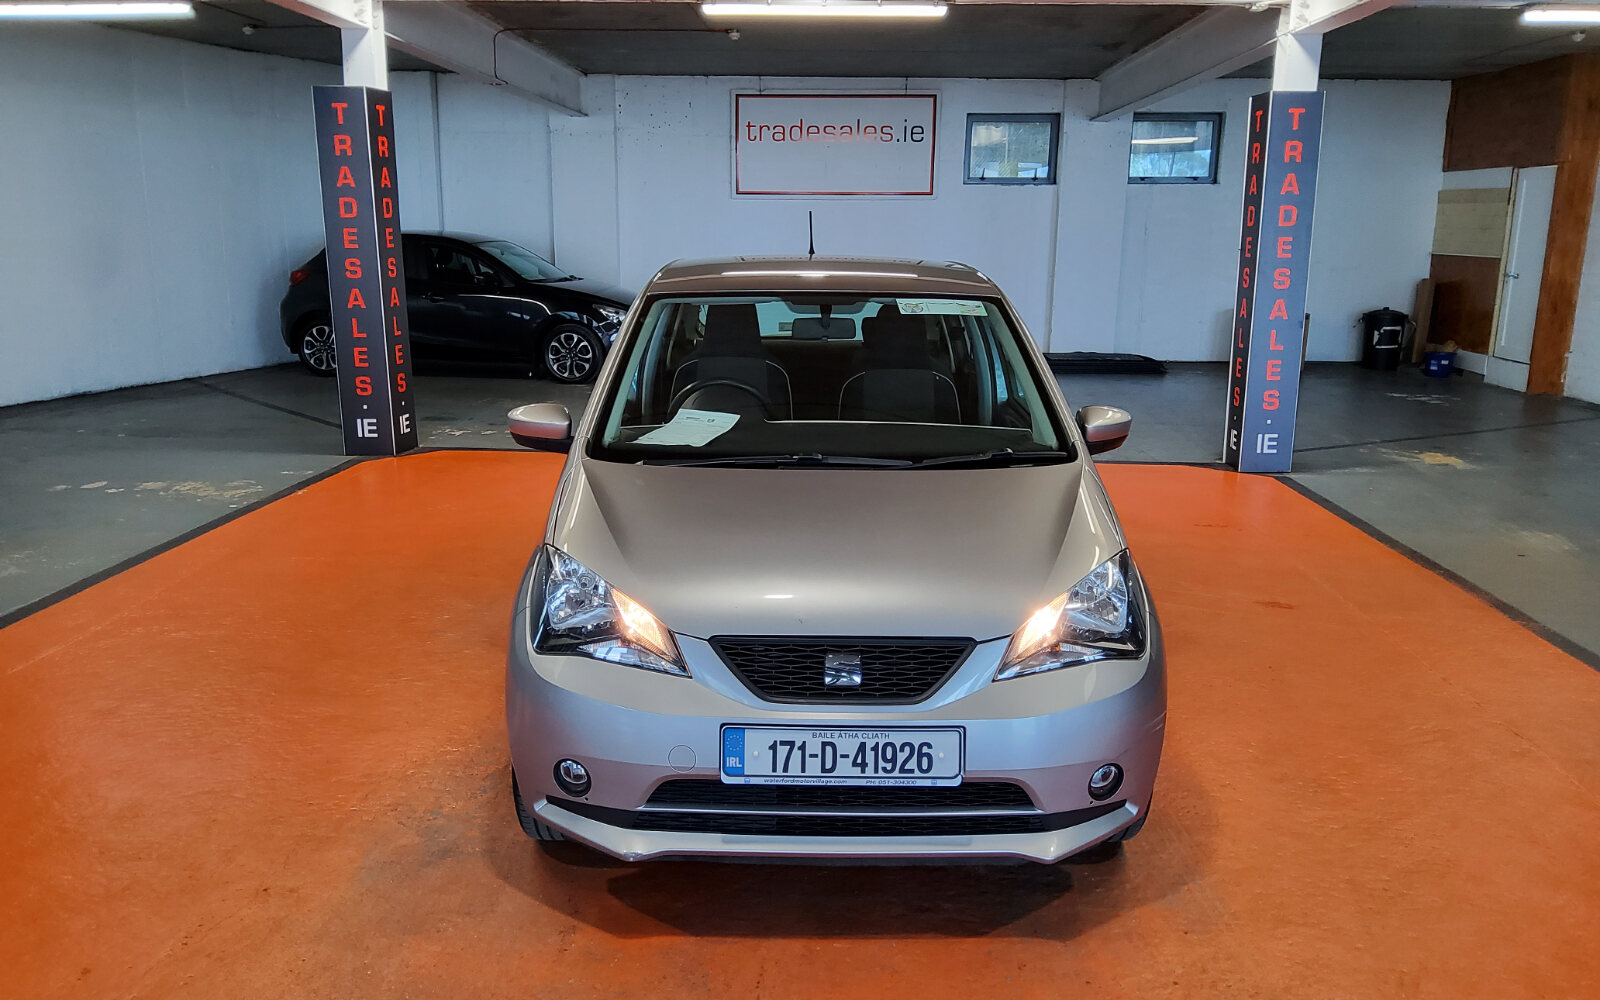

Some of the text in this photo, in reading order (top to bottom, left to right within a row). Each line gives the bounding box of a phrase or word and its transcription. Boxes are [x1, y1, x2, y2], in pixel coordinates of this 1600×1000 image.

[746, 118, 925, 143] tradesales.ie
[811, 730, 890, 740] BAILE ÁTHA CLIATH
[726, 756, 743, 768] IRL
[768, 739, 934, 775] 171-D-41926
